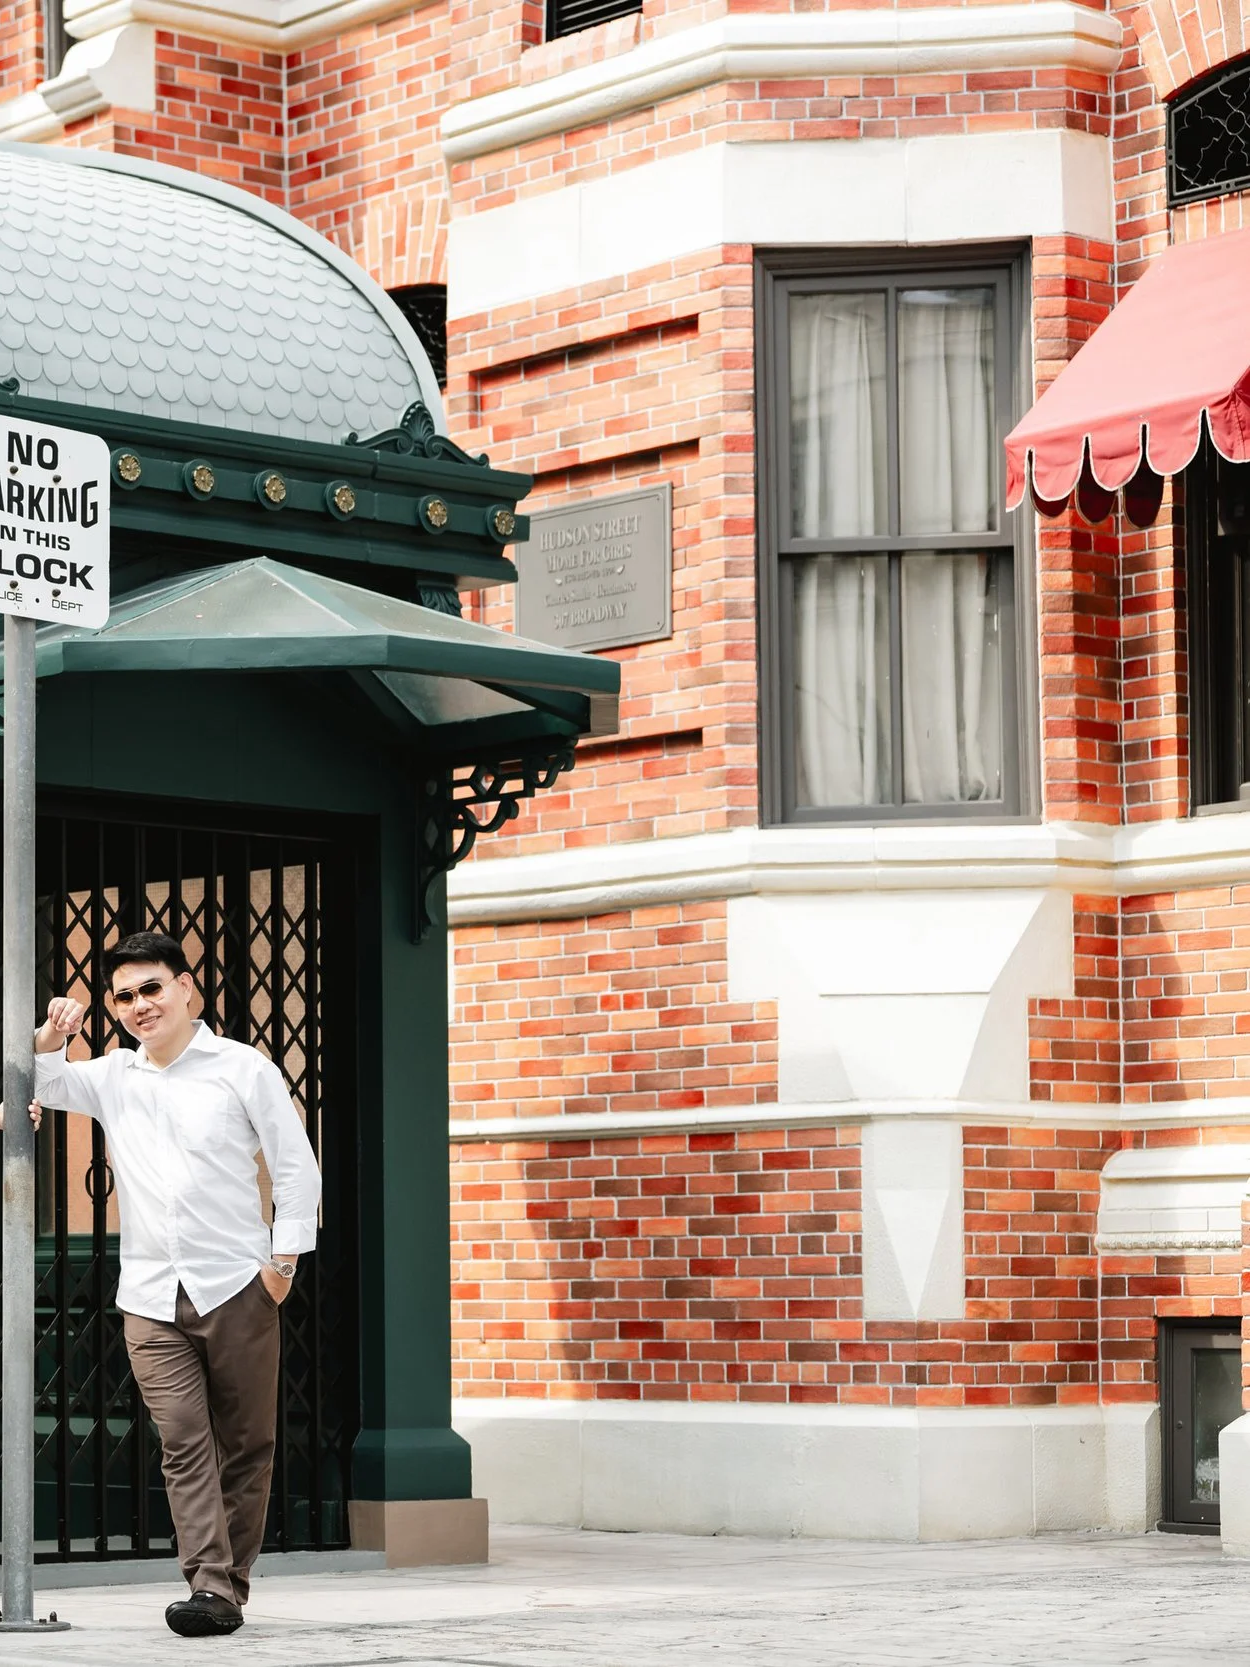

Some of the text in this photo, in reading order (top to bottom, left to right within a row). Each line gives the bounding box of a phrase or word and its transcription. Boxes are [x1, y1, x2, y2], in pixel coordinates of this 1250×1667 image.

[8, 431, 59, 470] NO
[23, 528, 70, 551] THIS
[540, 515, 640, 552] HUDSON STREET
[52, 599, 83, 613] DEPT
[570, 601, 626, 627] BROADWAY
